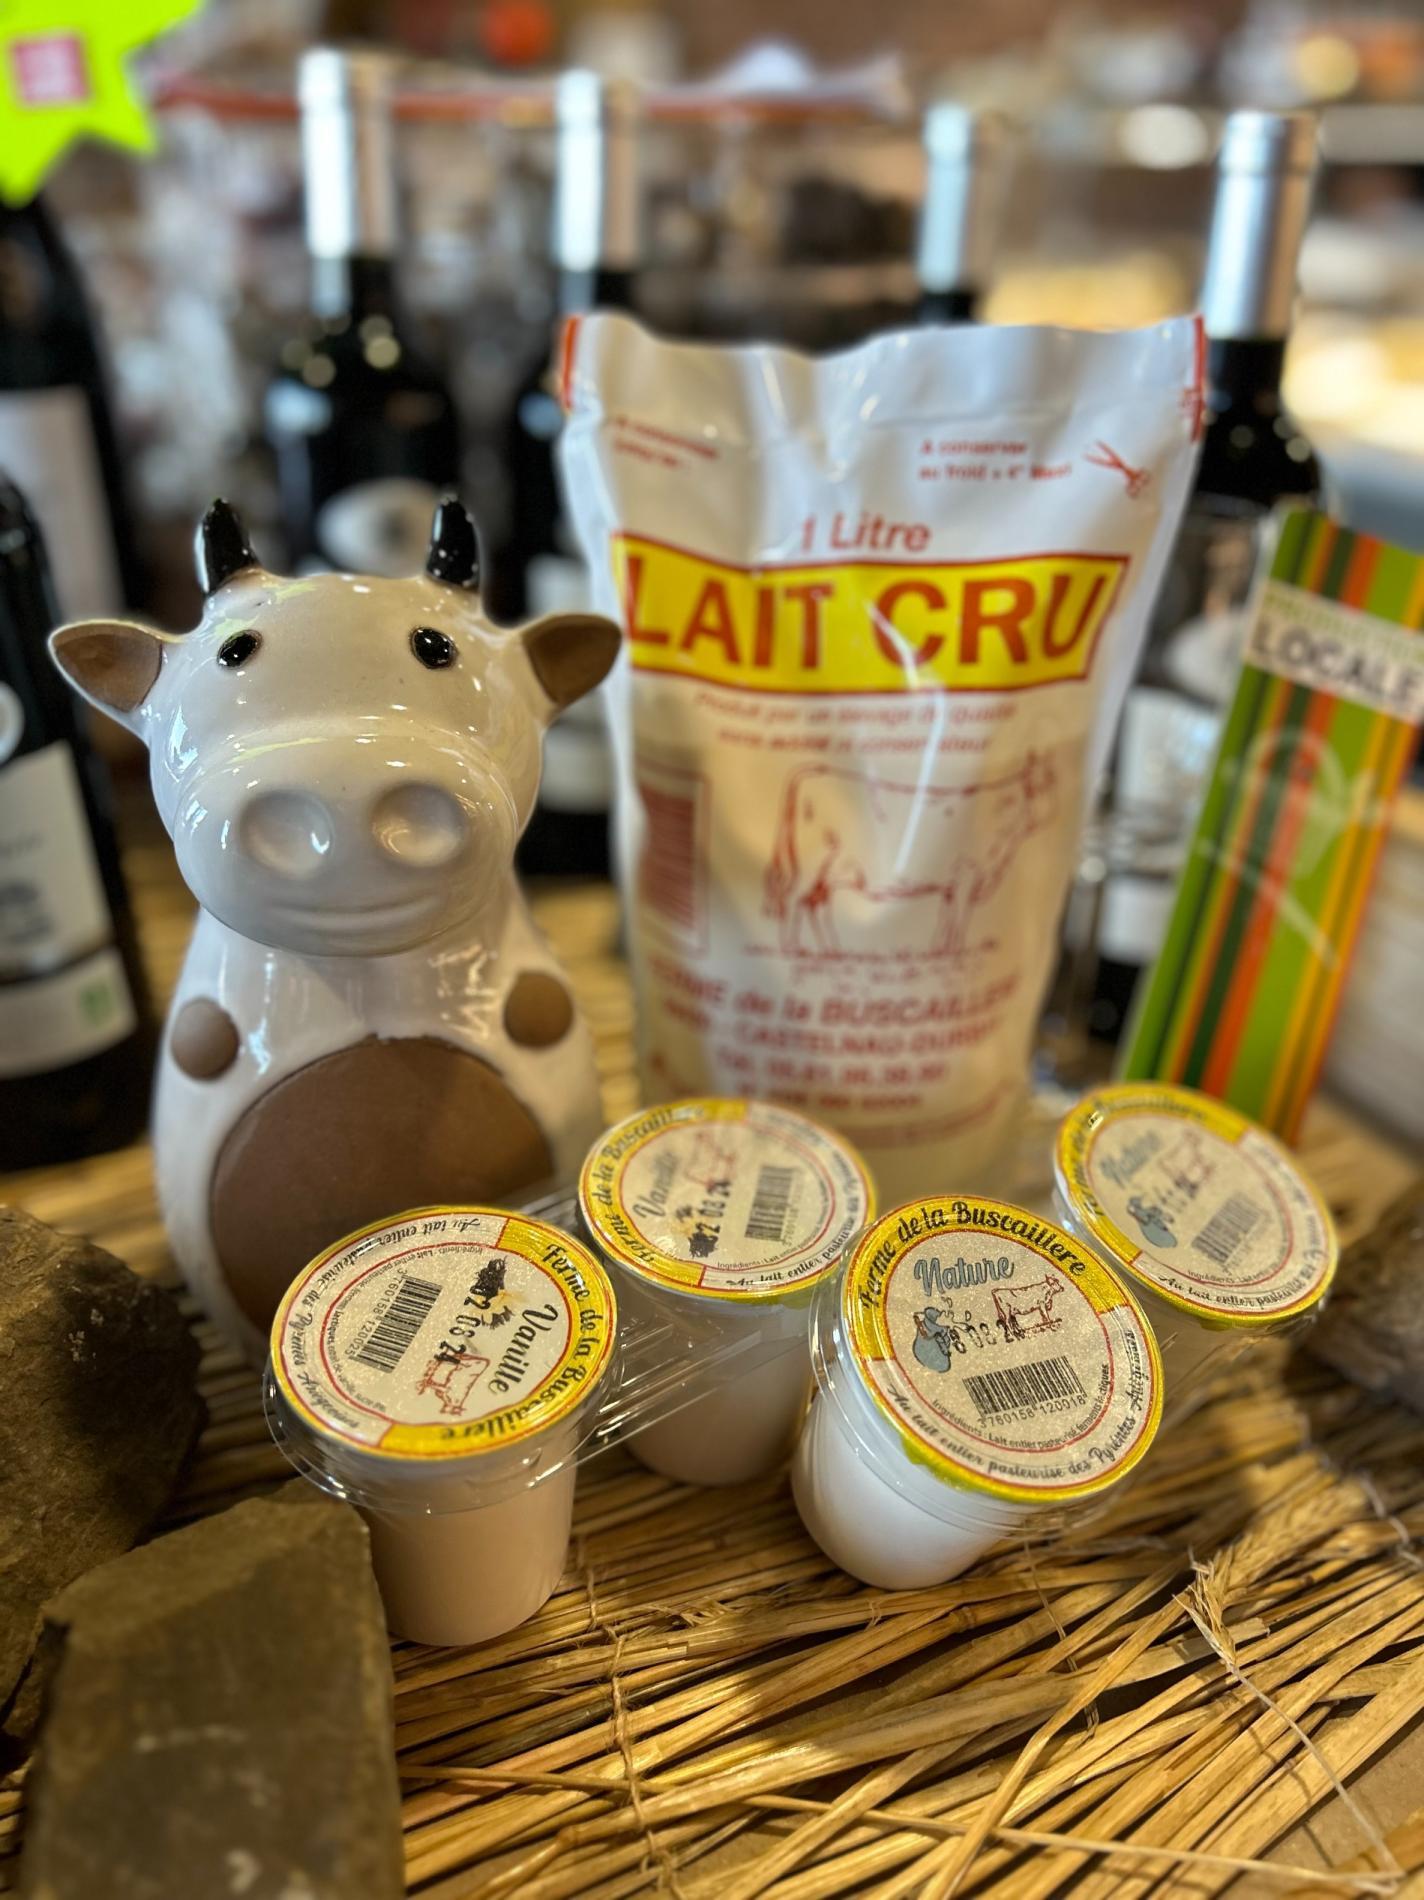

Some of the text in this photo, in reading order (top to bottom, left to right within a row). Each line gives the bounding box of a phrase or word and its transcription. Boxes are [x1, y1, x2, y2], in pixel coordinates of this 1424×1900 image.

[829, 511, 934, 554] Litre
[624, 554, 1110, 671] LAIT CRU
[378, 1225, 418, 1247] entier
[423, 1219, 448, 1236] lait
[541, 1243, 591, 1302] Ferme
[857, 1239, 897, 1310] Ferme
[897, 1216, 923, 1244] de
[921, 1207, 949, 1231] la
[912, 1256, 1015, 1297] Nature
[372, 1276, 403, 1314] 760158
[344, 1319, 376, 1356] 120025
[579, 1307, 604, 1333] de
[487, 1303, 559, 1396] Vanille
[574, 1337, 601, 1360] la
[1039, 1394, 1087, 1416] 120018
[886, 1383, 911, 1412] Au
[911, 1413, 939, 1437] lait
[939, 1436, 985, 1466] entier
[1068, 1458, 1093, 1476] des
